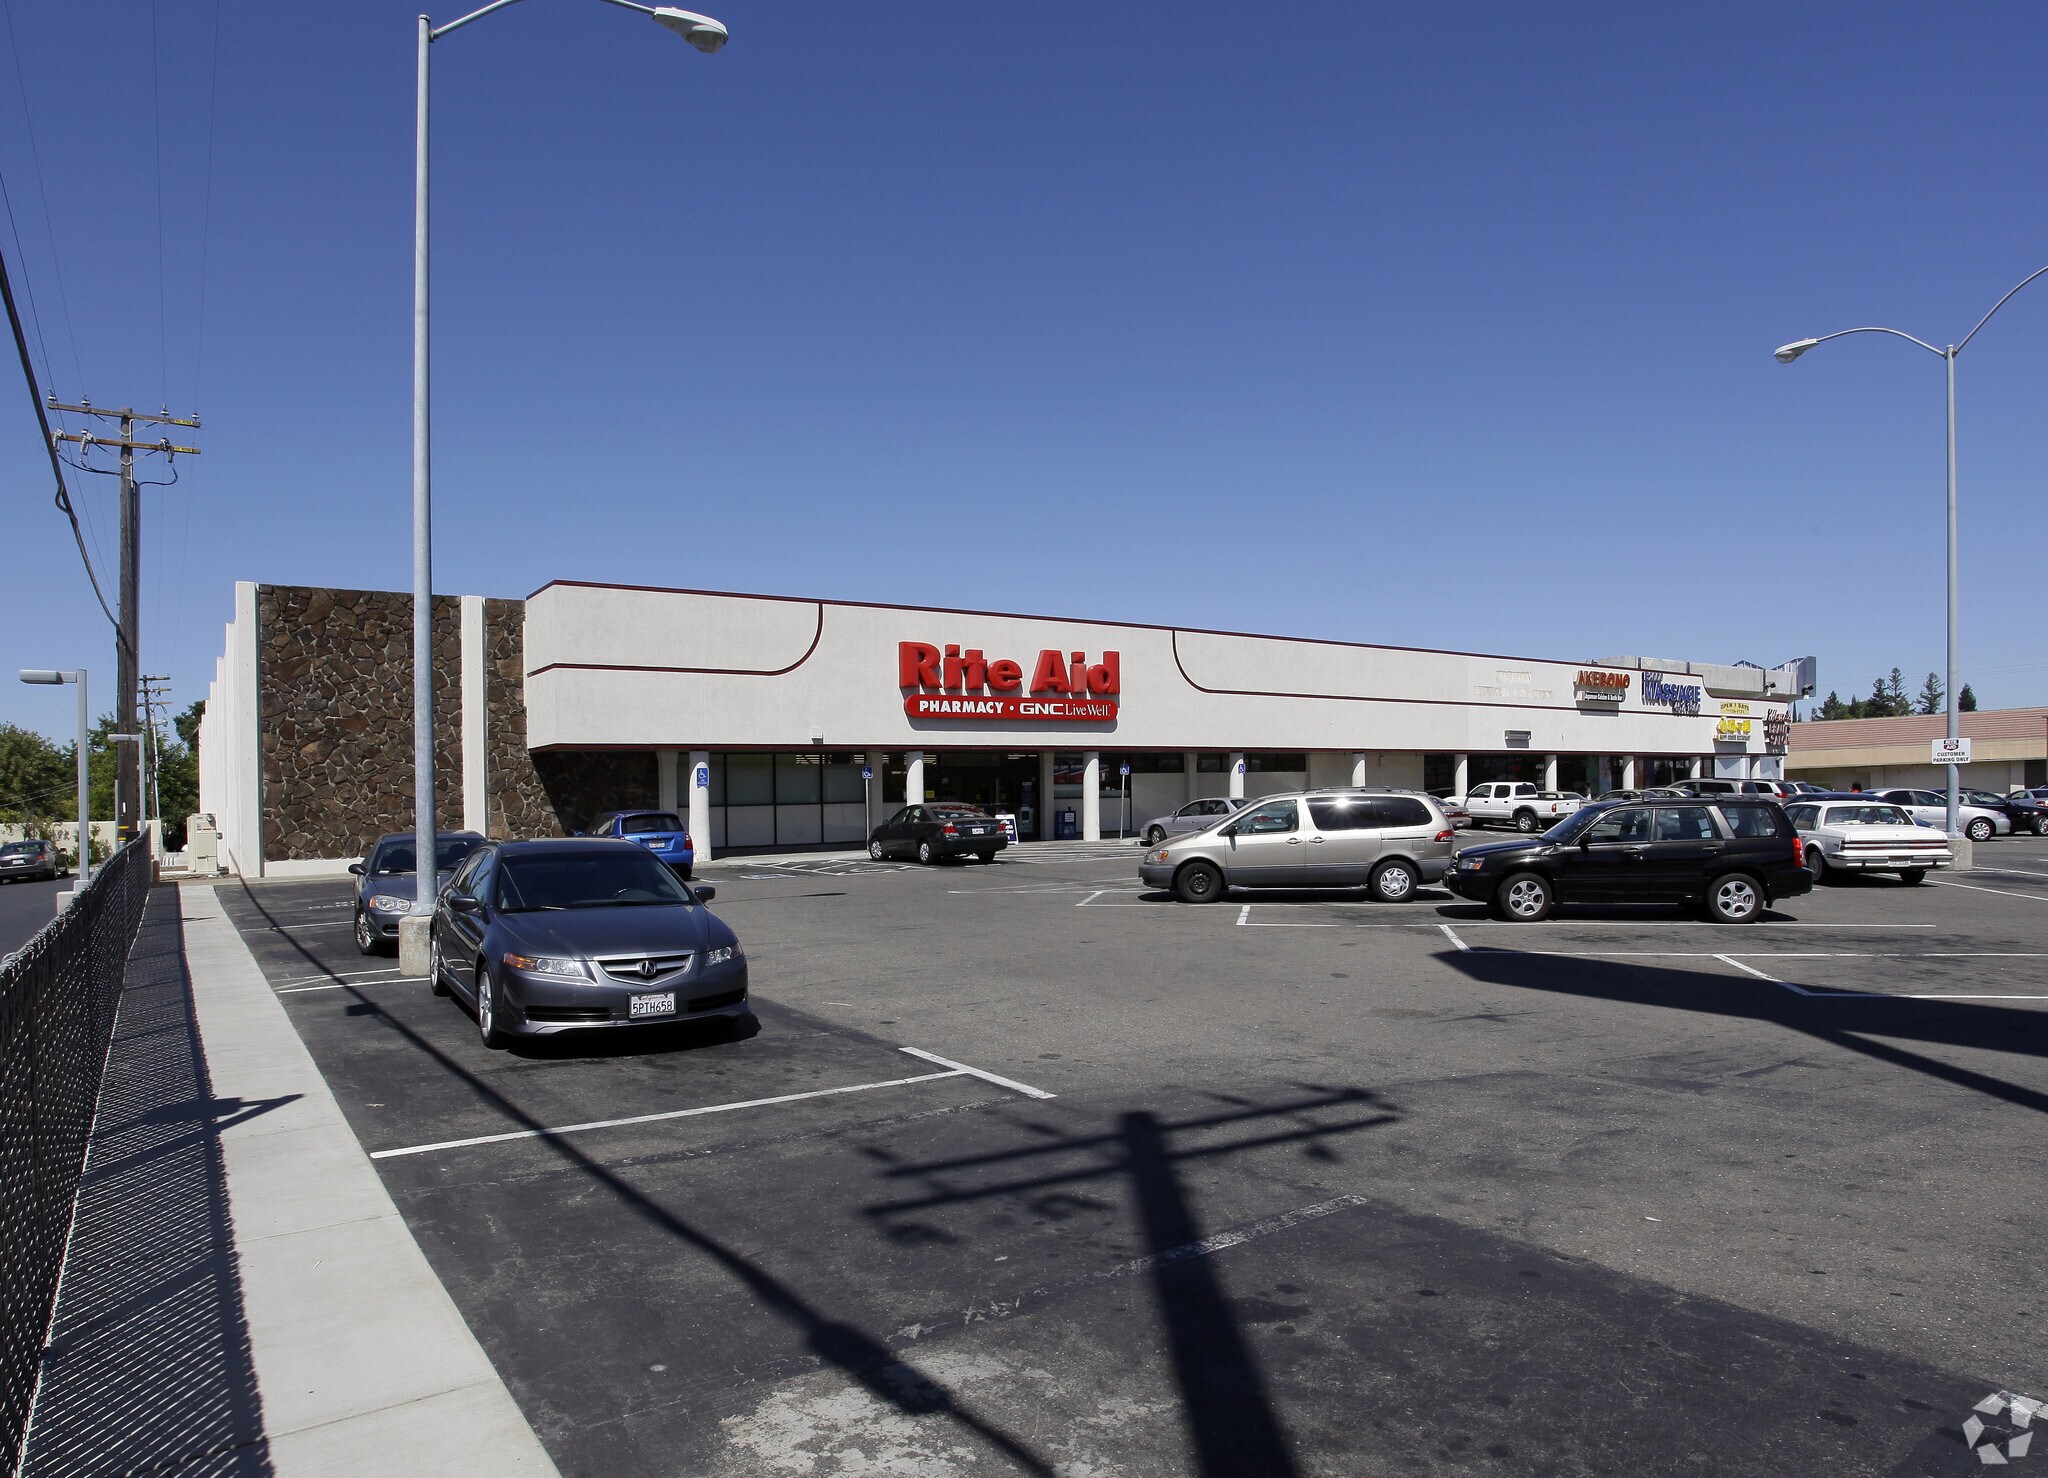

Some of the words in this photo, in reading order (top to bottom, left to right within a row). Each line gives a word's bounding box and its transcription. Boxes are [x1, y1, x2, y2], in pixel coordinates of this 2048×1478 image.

[899, 641, 1022, 691] Rite
[1029, 650, 1120, 694] Aid
[1577, 670, 1630, 688] AKEBONO
[1644, 682, 1701, 702] MASSAGE
[919, 700, 1004, 714] PHARMACY
[1019, 702, 1064, 715] GNC
[1738, 703, 1750, 711] DAYS
[633, 1000, 673, 1014] 5PTH658
